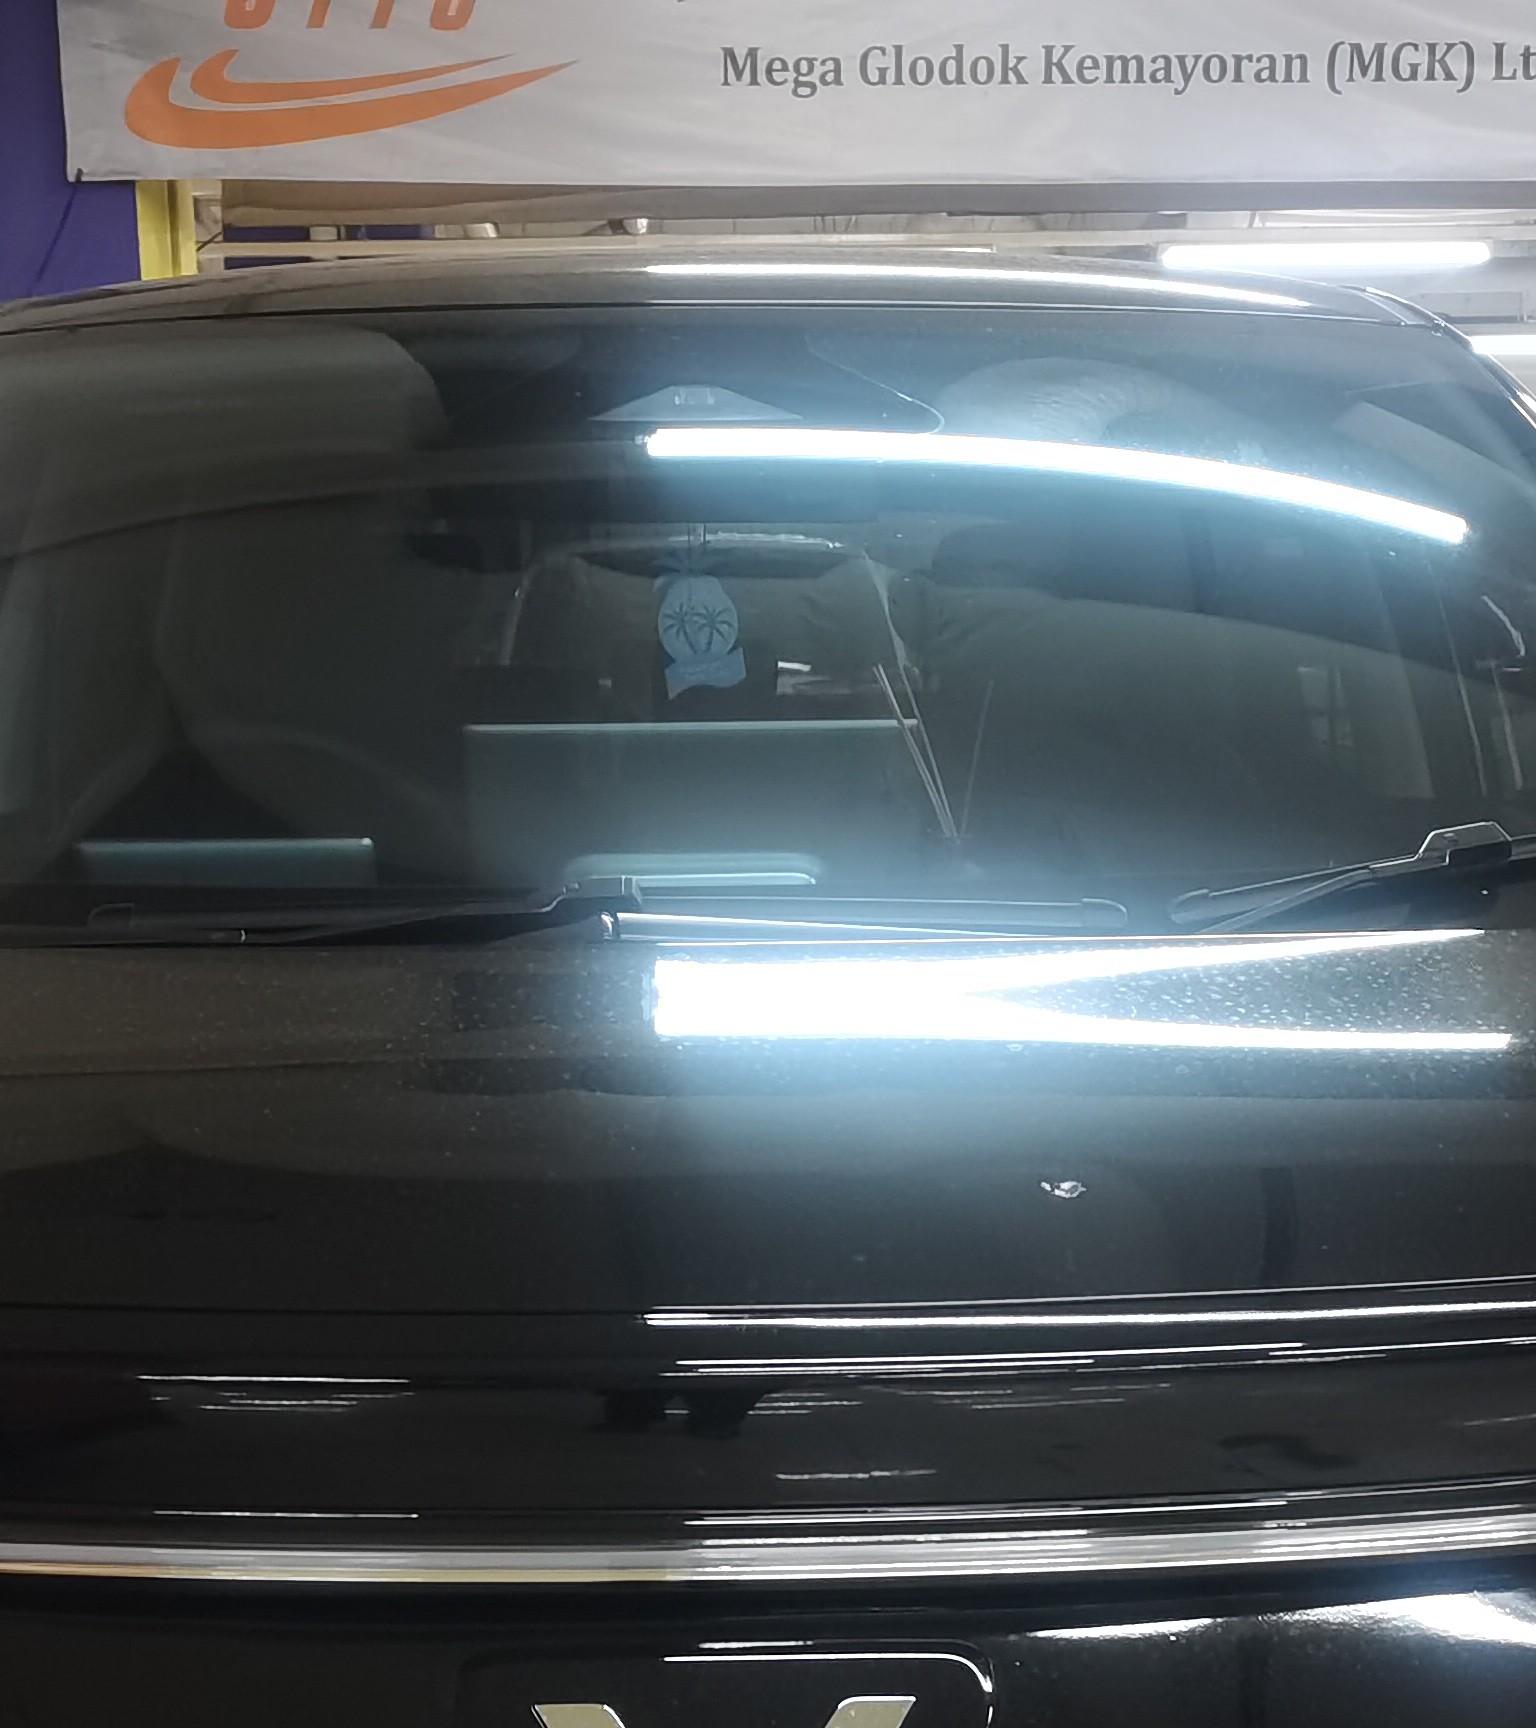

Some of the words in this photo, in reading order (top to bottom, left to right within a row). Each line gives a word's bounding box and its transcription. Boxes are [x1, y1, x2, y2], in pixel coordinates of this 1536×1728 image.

[720, 45, 845, 99] Mega
[858, 42, 1030, 87] Glodok
[1040, 43, 1311, 96] Kemayoran
[1325, 39, 1476, 95] (MGK)
